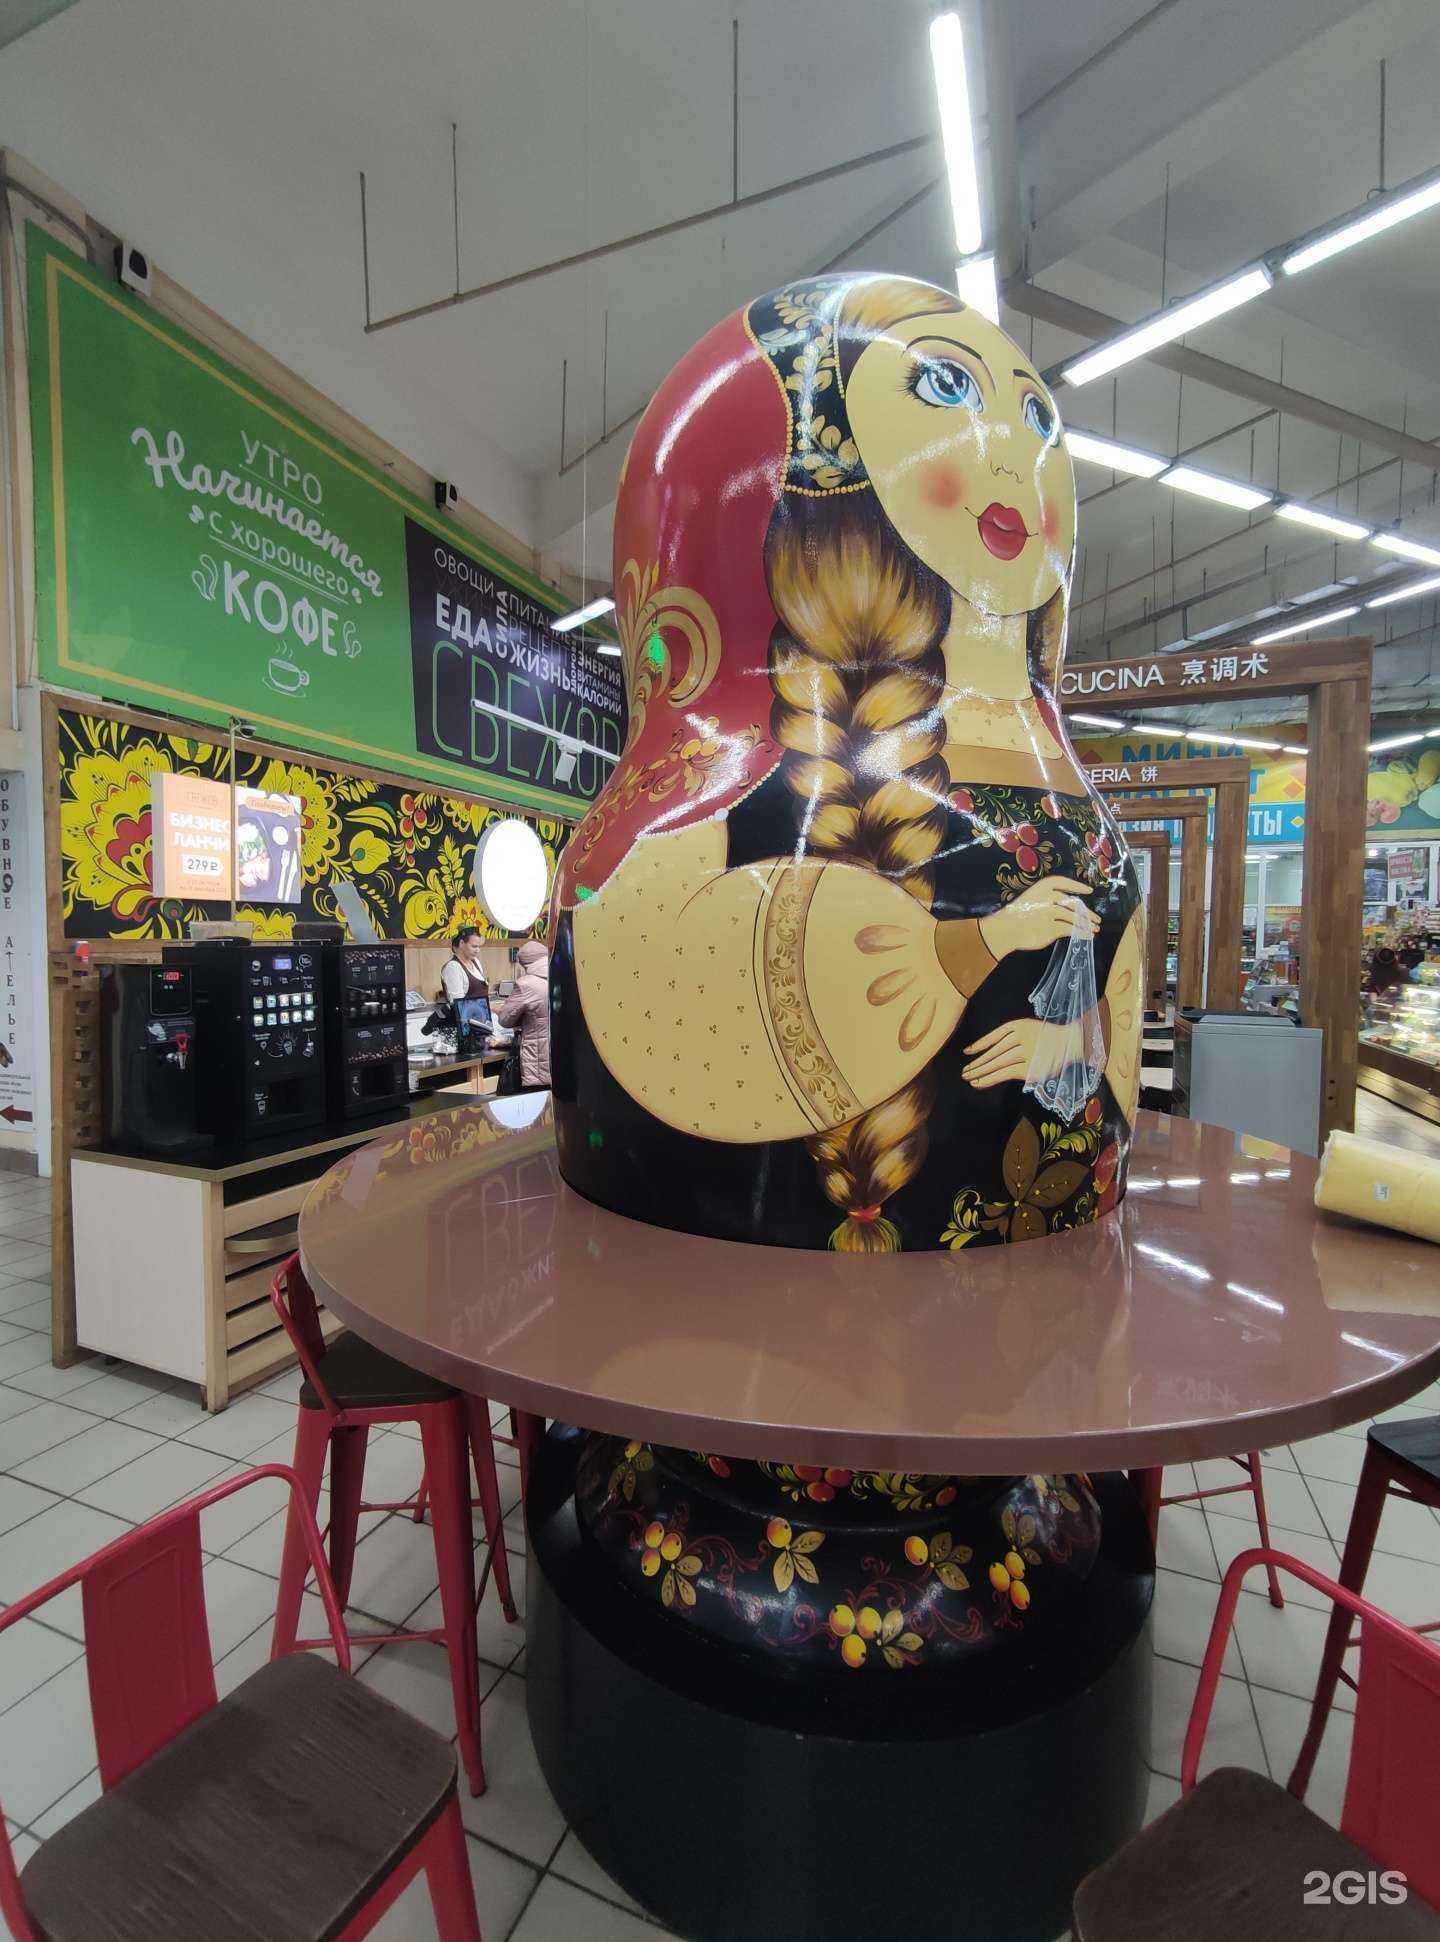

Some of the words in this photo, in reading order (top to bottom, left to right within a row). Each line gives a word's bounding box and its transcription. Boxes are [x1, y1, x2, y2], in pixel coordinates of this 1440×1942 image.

[241, 430, 323, 505] УТРО
[131, 427, 384, 597] Начинается
[230, 519, 349, 596] хорошего
[434, 547, 494, 598] ОВОЩИ
[223, 560, 339, 657] КОФЕ
[436, 591, 493, 654] ЕДА
[496, 590, 508, 659] СИЛА
[509, 640, 571, 691] ЖИЗНЬ
[577, 650, 621, 687] ЭНЕРГИЯ
[1060, 664, 1165, 695] CUCINA
[1179, 652, 1269, 686] 烹调术
[577, 683, 622, 717] КАЛОРИИ
[1247, 810, 1282, 836] ТЫ
